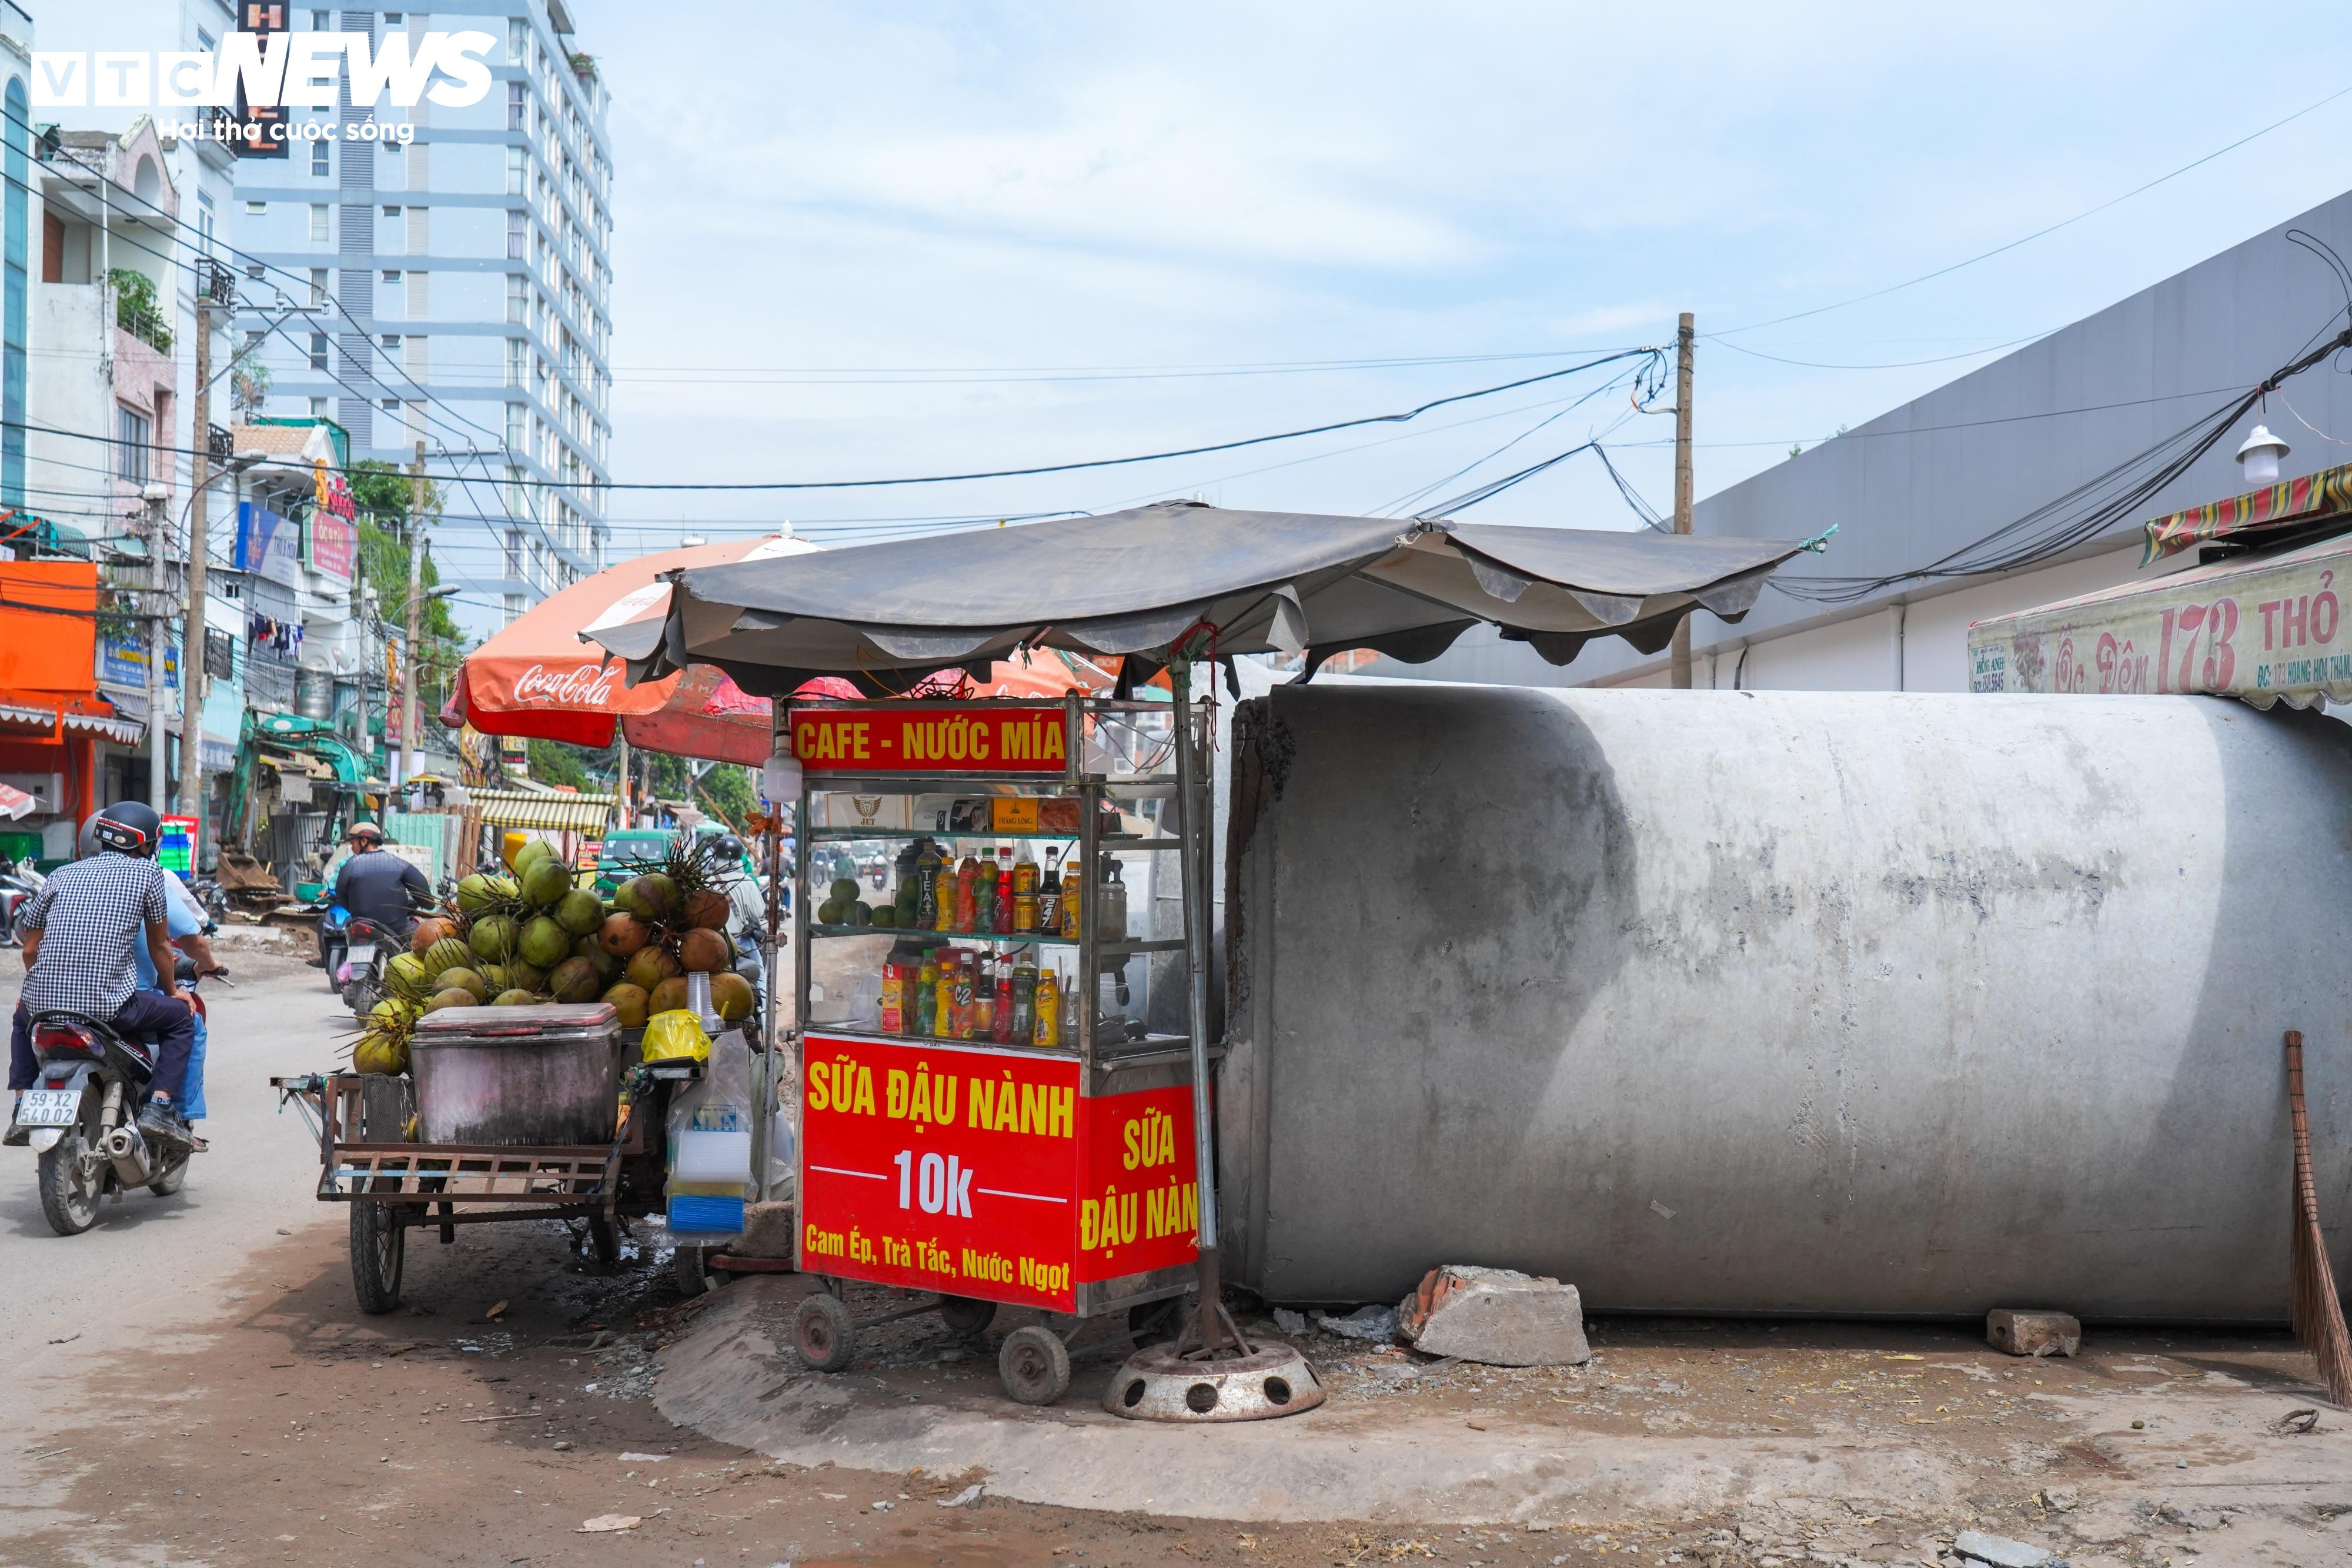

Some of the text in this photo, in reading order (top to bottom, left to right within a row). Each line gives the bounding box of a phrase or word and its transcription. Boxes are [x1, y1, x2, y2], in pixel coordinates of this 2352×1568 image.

[2259, 570, 2339, 651] THỎ
[1991, 657, 2004, 671] ANH
[2155, 598, 2239, 693] 173
[514, 664, 622, 705] Coca-Cola
[2258, 665, 2271, 687] ĐC:
[2274, 663, 2286, 684] 173
[2288, 654, 2311, 685] HOÀNG
[2314, 658, 2328, 682] HOA
[797, 723, 870, 759] CAFE
[903, 714, 989, 760] NƯỚC
[1001, 713, 1065, 759] MÍA
[1041, 898, 1055, 926] 247
[956, 985, 972, 1006] C2
[22, 1109, 72, 1123] 540.02
[30, 1093, 72, 1107] 59-X2
[809, 1054, 1074, 1138] SỮA ĐẬU NÀNH
[1123, 1106, 1175, 1170] SỮA
[894, 1150, 973, 1218] 10k
[1081, 1175, 1198, 1258] ĐẬU NÀN
[806, 1224, 1069, 1295] Cam Ép, Trà Tắc, Nước Ngọt
